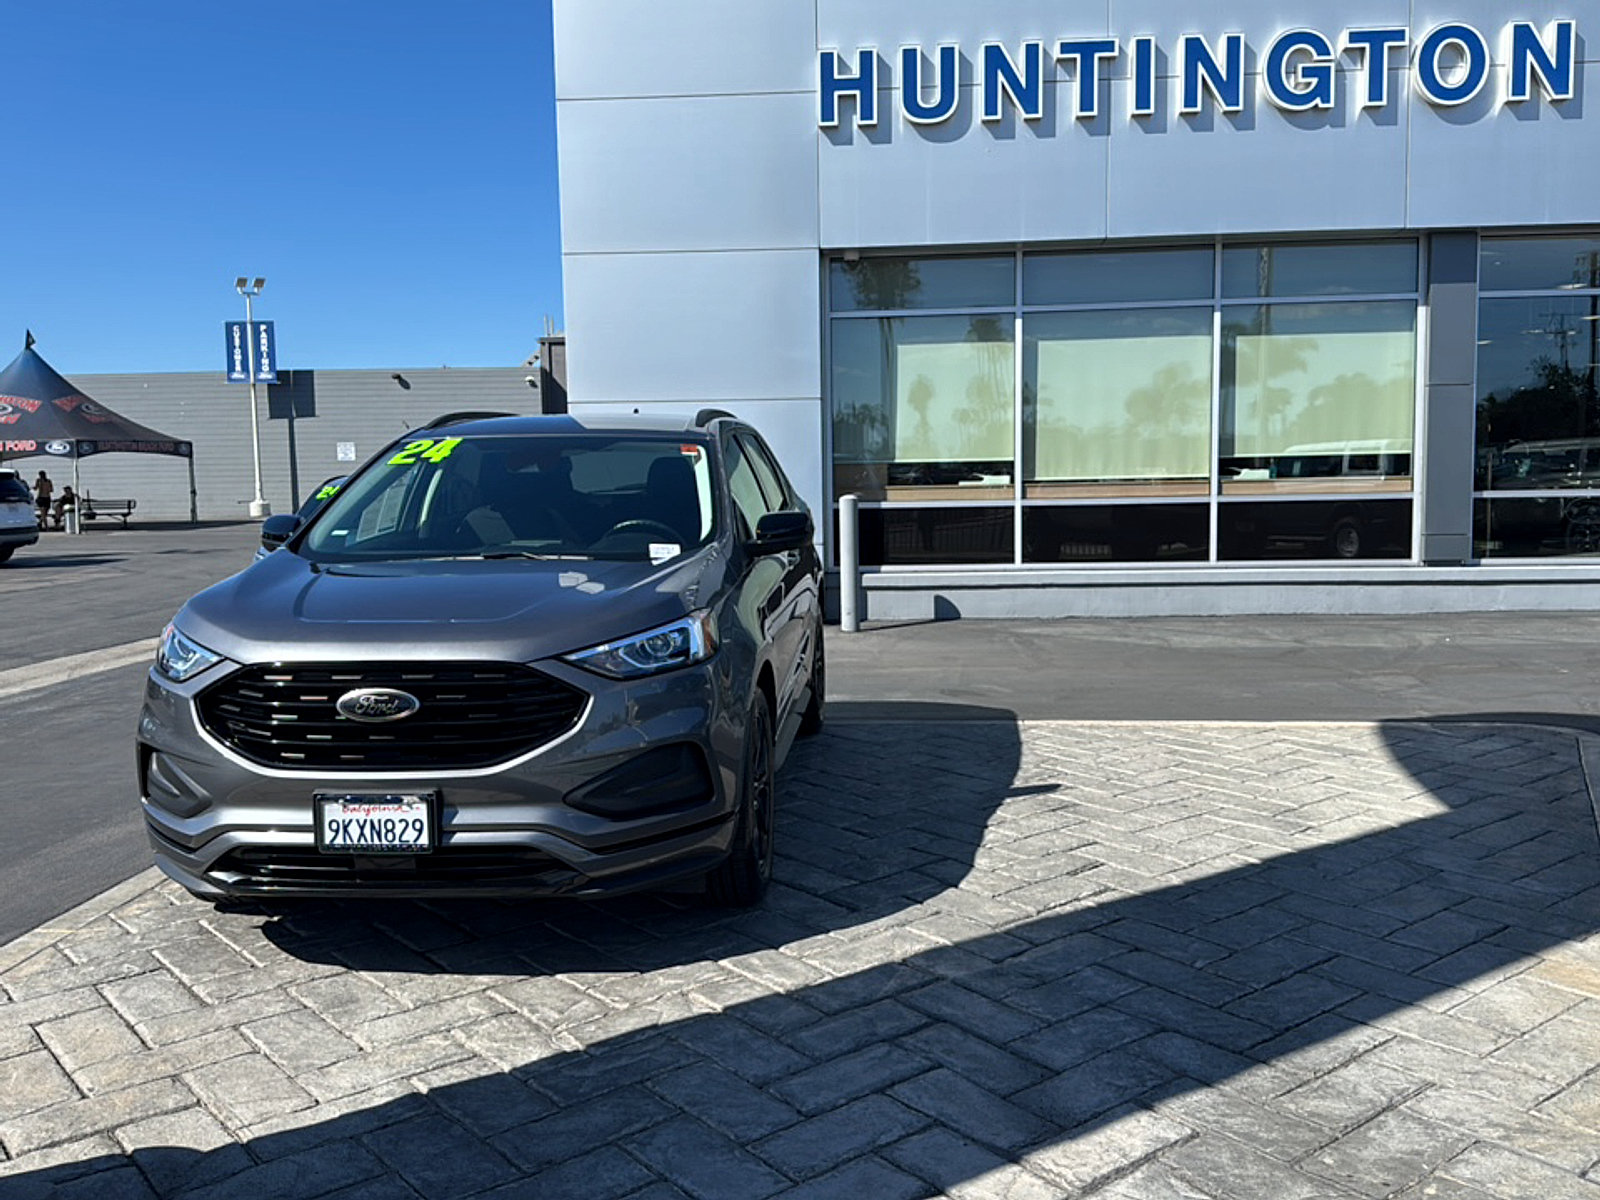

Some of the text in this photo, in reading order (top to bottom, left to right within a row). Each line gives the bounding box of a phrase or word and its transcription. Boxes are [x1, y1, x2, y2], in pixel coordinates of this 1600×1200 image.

[818, 19, 1576, 127] HUNTINGTON
[260, 324, 269, 372] PARKING
[5, 440, 37, 451] FORD
[387, 436, 465, 465] 24
[356, 695, 398, 713] Ford
[328, 818, 424, 843] 9KXN829
